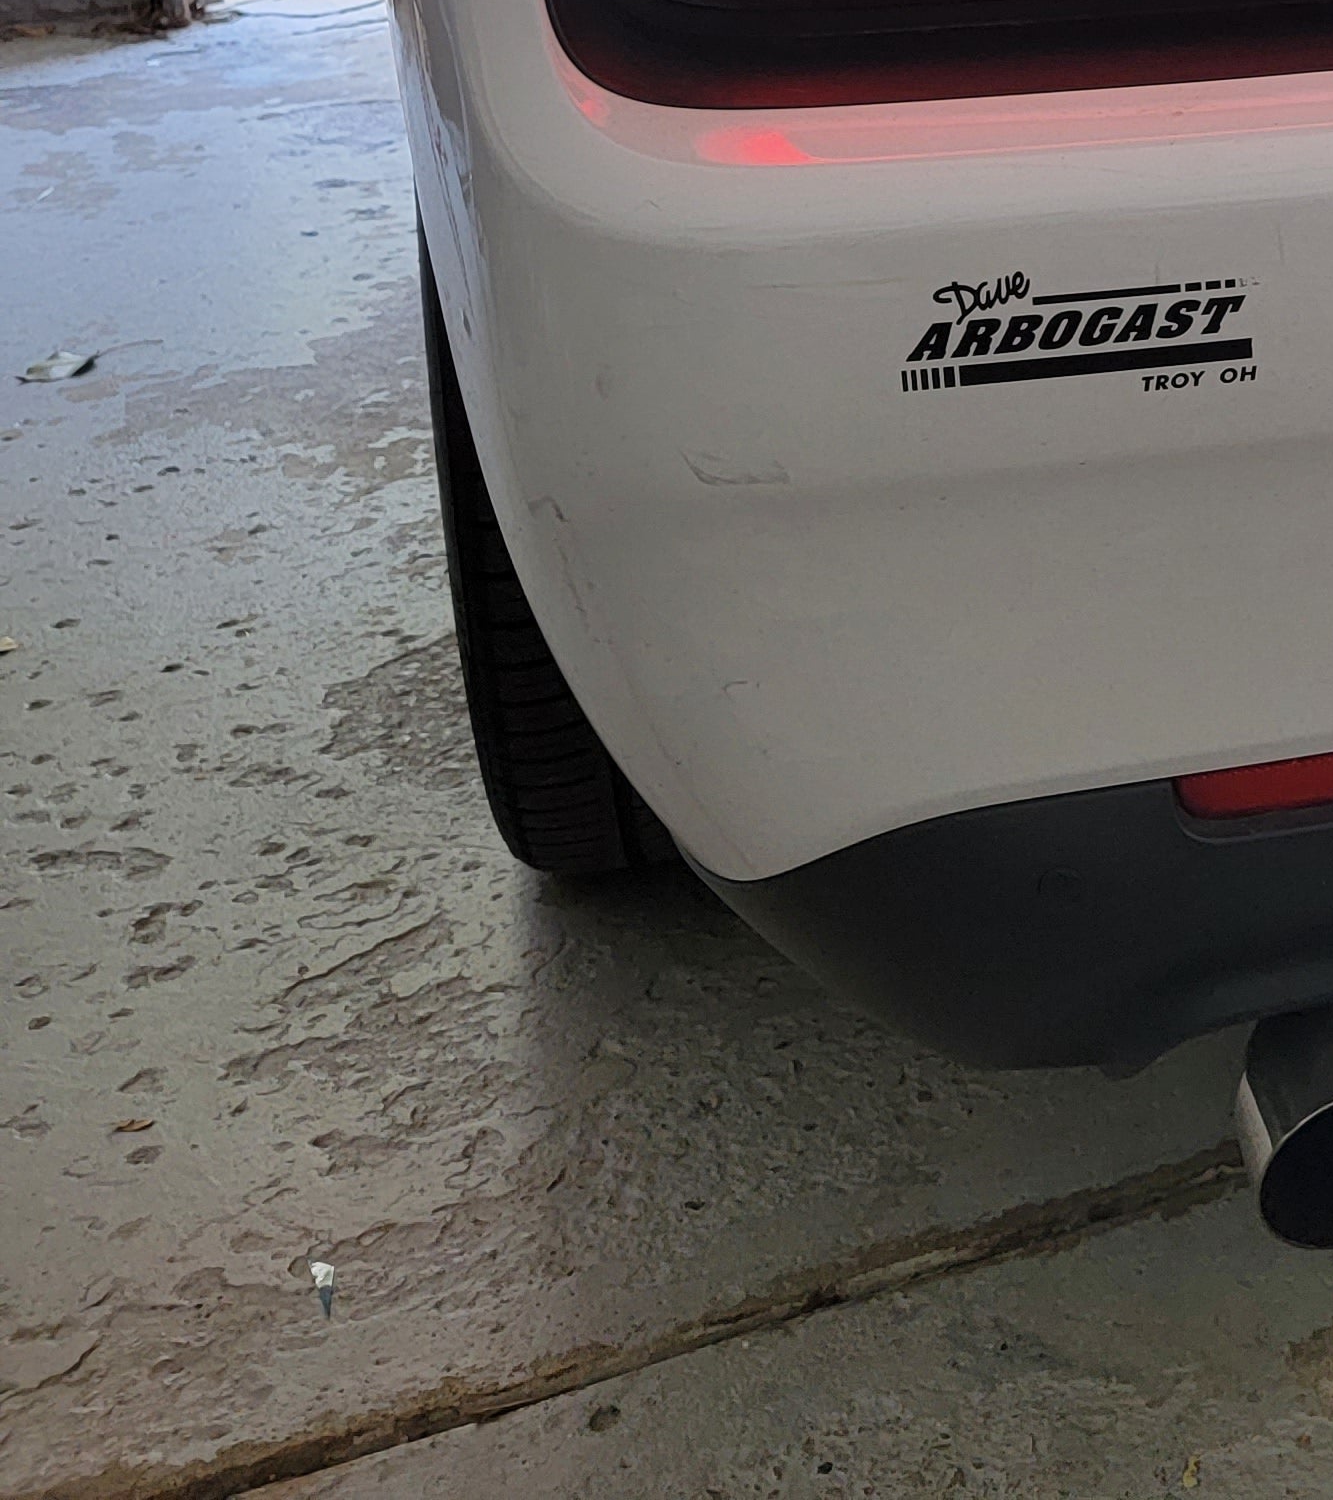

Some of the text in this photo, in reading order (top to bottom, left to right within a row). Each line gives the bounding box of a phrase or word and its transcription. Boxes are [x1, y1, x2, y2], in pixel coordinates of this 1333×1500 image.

[932, 271, 1030, 325] Dave
[905, 295, 1246, 362] ARBOGAST
[1142, 365, 1257, 392] TROY OH
